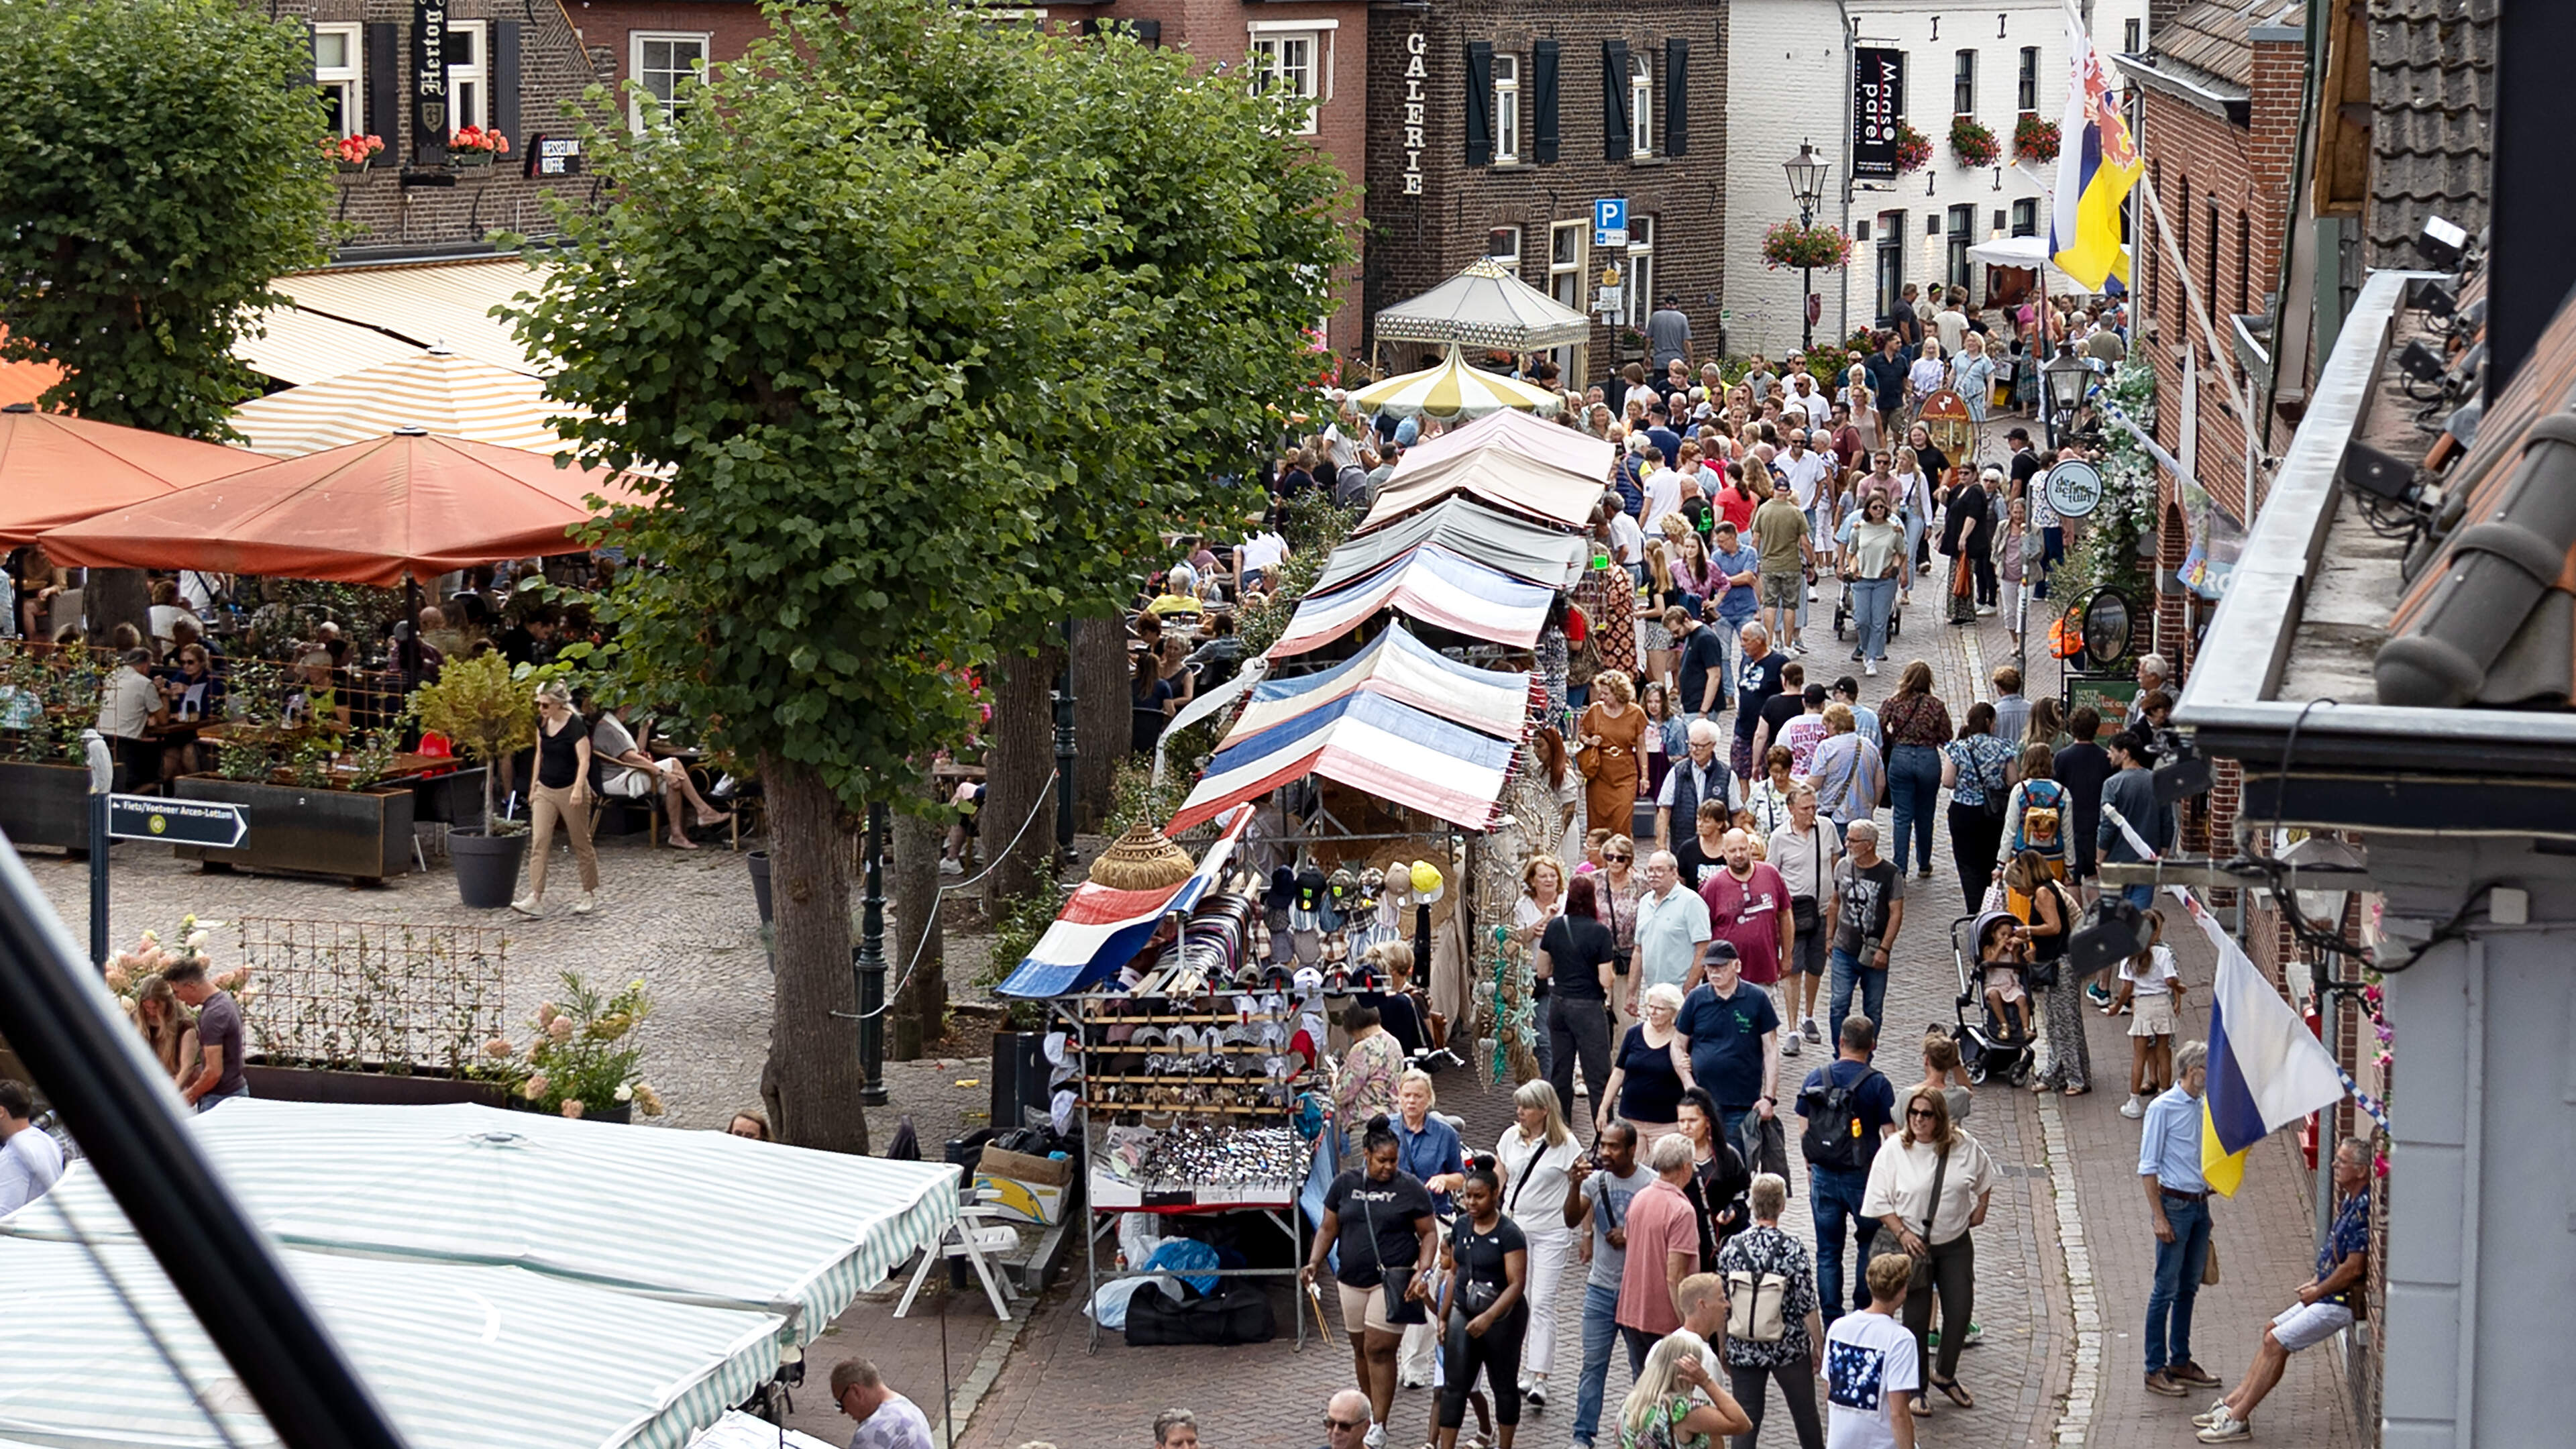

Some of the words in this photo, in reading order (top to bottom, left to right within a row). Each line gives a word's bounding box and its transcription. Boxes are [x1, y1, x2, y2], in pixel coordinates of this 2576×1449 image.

[421, 9, 447, 96] Hertog
[1402, 33, 1428, 195] GALERIE
[1862, 84, 1884, 145] parel
[1880, 61, 1897, 125] Maas
[1602, 203, 1618, 226] P
